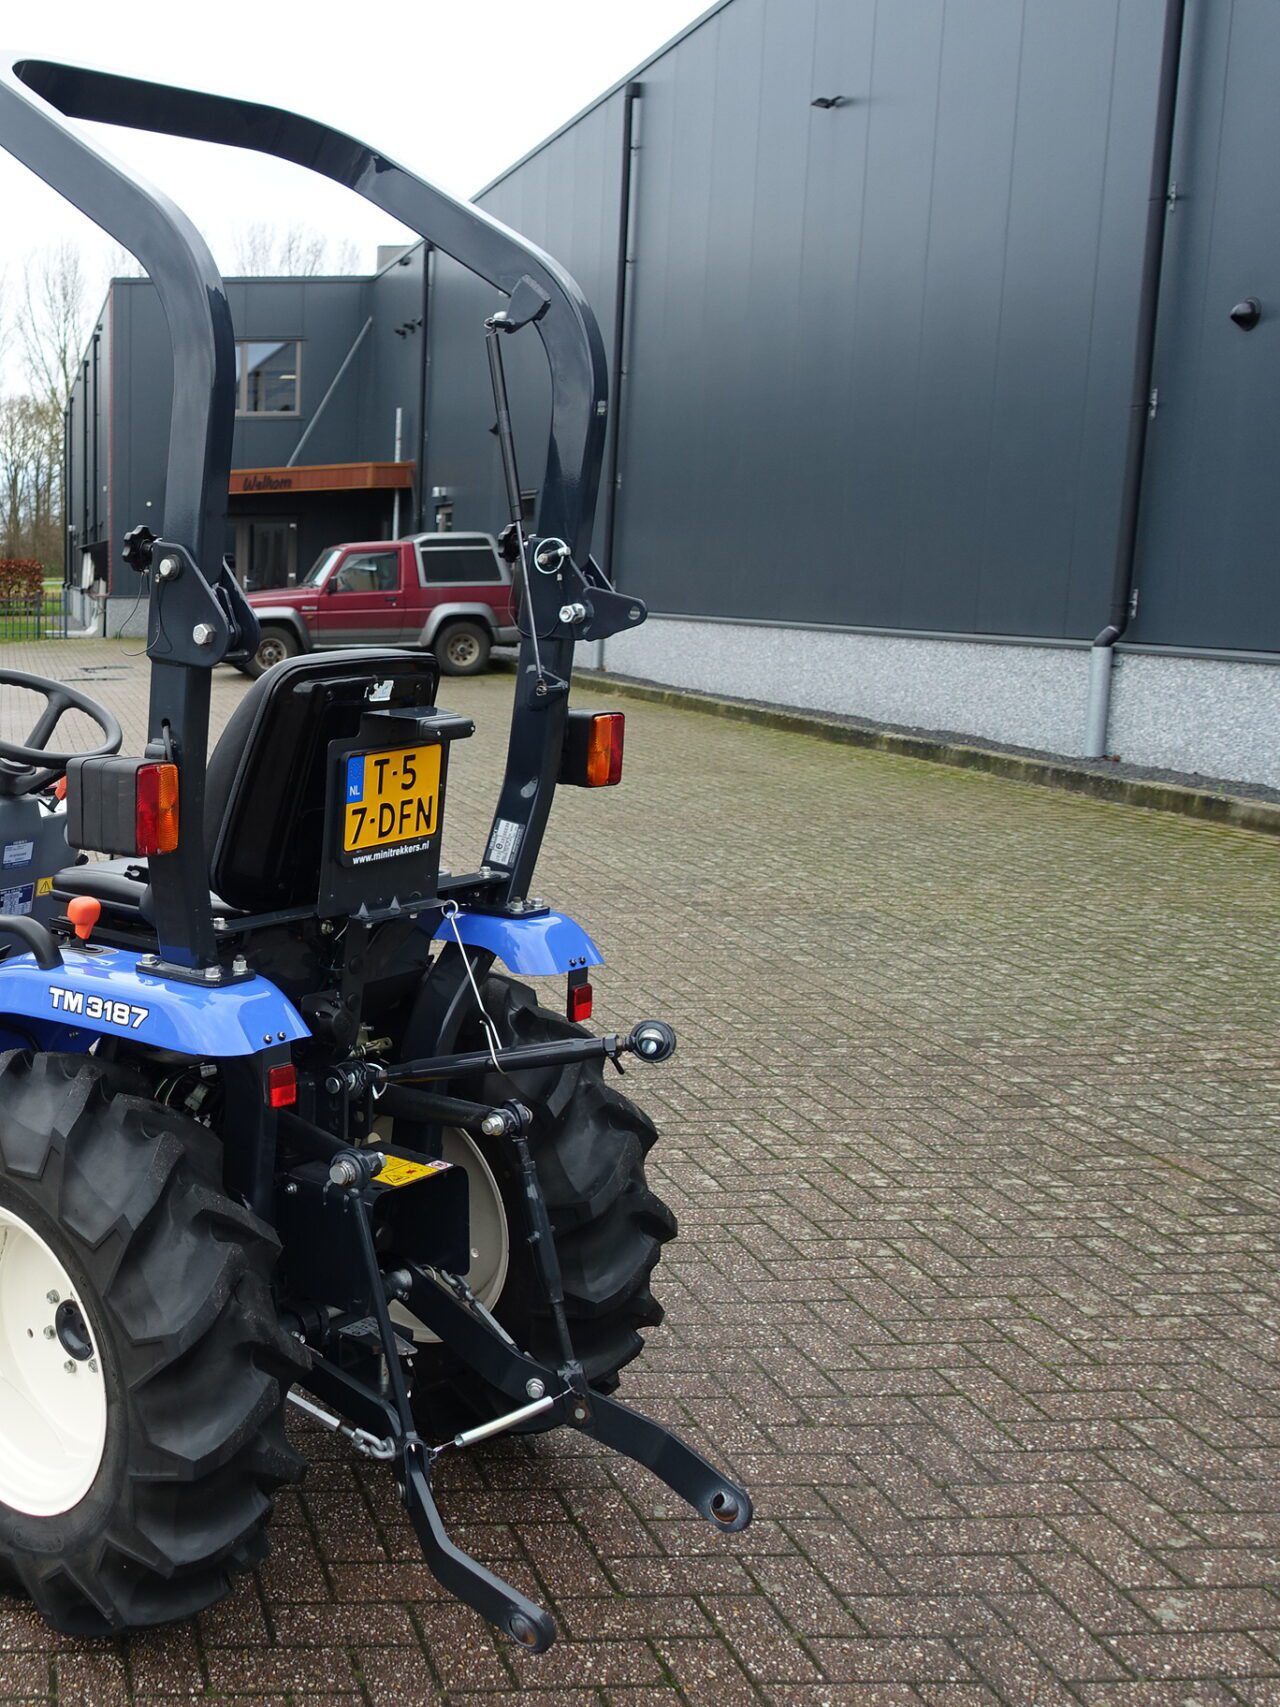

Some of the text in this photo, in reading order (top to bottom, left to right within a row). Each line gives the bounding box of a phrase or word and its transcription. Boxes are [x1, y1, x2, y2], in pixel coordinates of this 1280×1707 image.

[349, 785, 361, 797] NL
[351, 795, 433, 844] 7-DFN
[352, 840, 429, 865] www.minitrekkers.nl
[49, 985, 149, 1029] TM 3187
